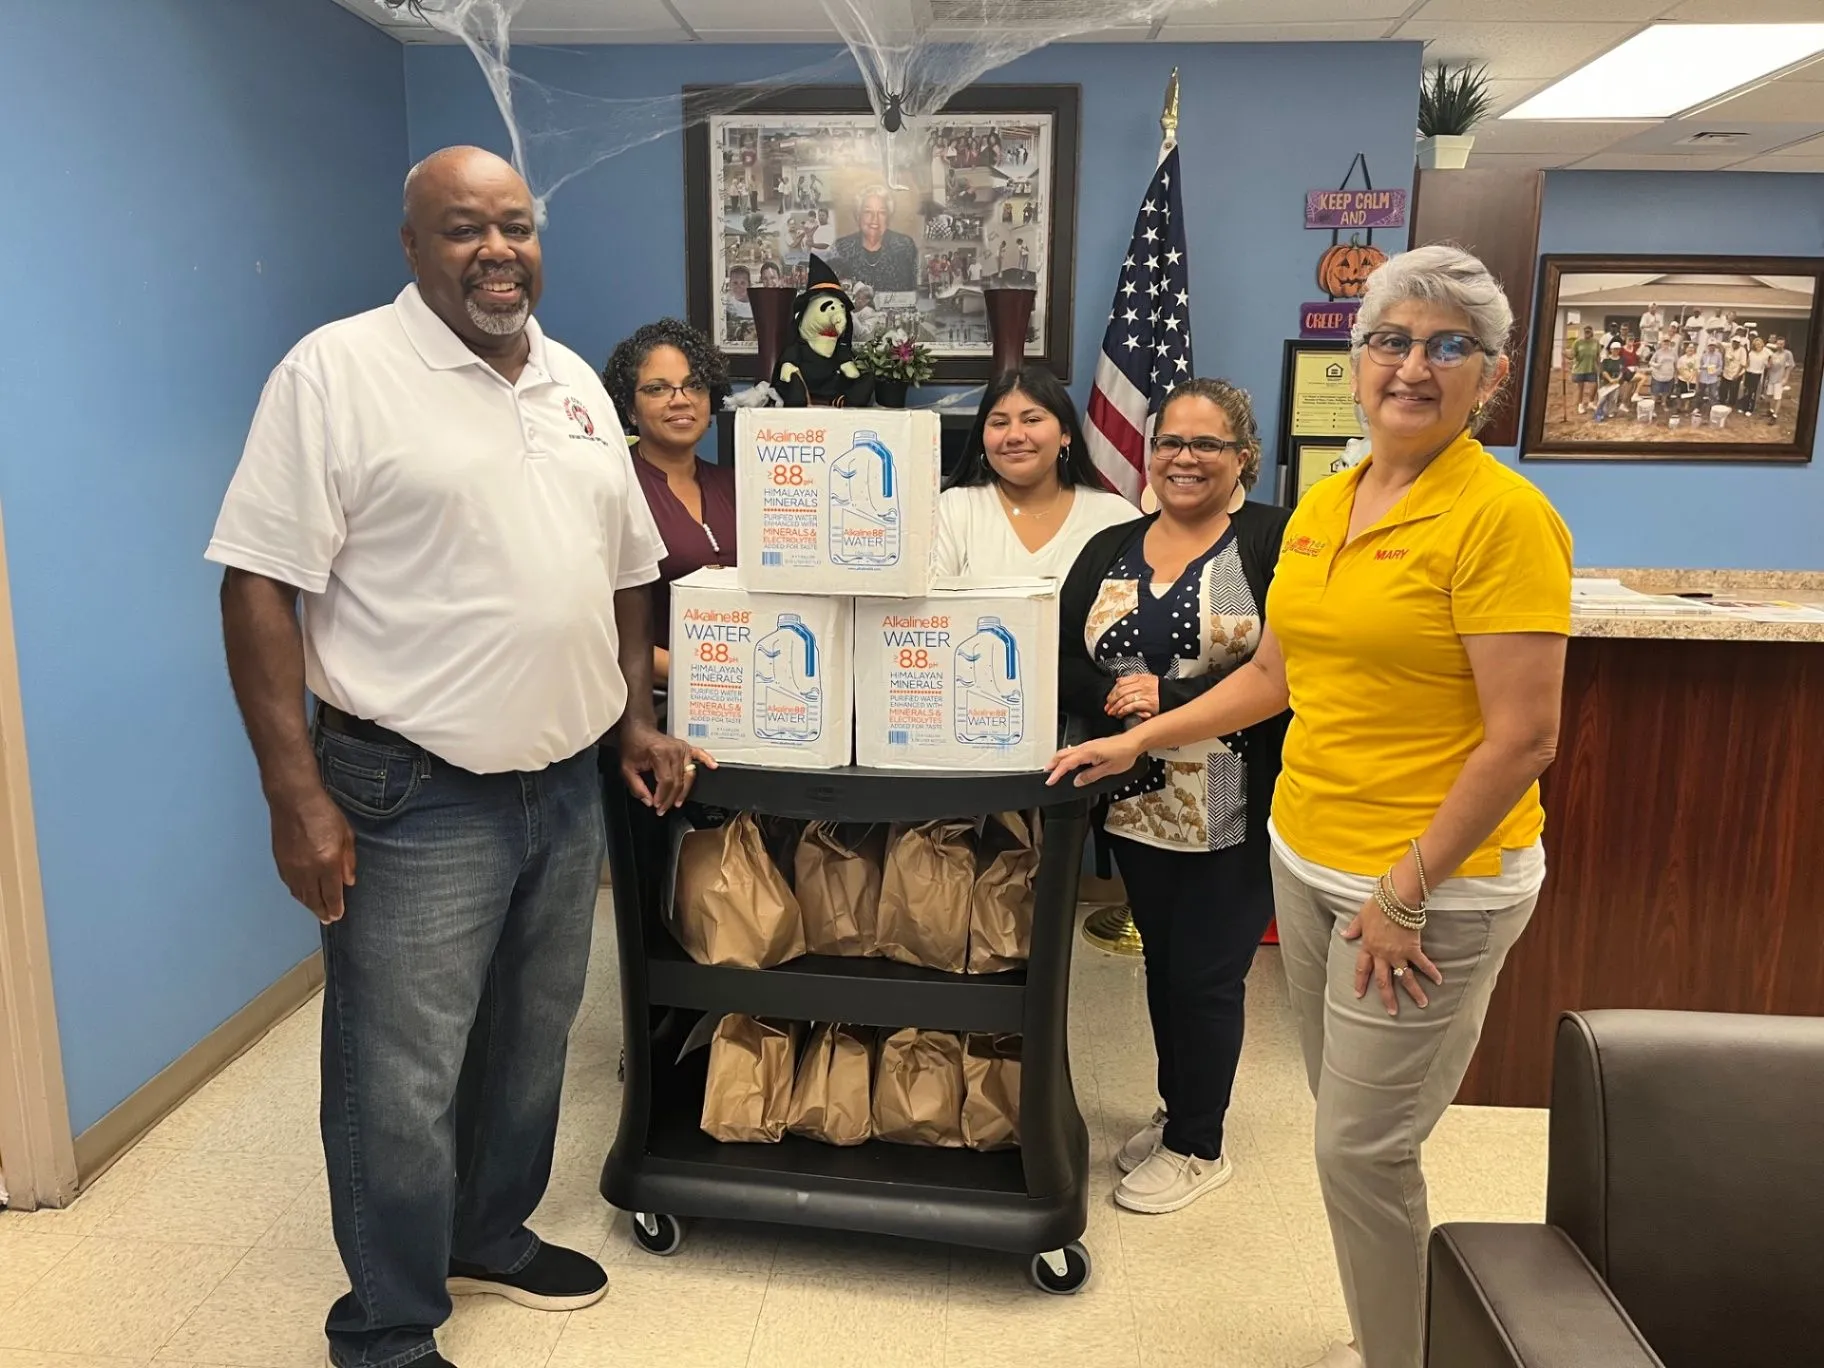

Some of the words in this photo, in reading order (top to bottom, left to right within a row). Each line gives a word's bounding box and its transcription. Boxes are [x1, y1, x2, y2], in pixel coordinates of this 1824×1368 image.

[1320, 193, 1351, 210] KEEP
[1355, 192, 1389, 209] CALM
[1341, 211, 1367, 225] AND
[1305, 312, 1343, 329] CREEP
[757, 445, 826, 463] WATER
[764, 488, 818, 497] HIMALAYAN
[764, 498, 818, 507] MINERALS
[763, 528, 809, 536] MINERALS
[844, 537, 883, 546] WATER
[1373, 549, 1410, 561] MARY
[684, 623, 751, 642] WATER
[883, 631, 951, 647] WATER
[690, 664, 743, 674] HIMALAYAN
[690, 673, 743, 683] MINERALS
[890, 680, 943, 689] MINERALS
[690, 701, 734, 710] MINERALS
[890, 708, 934, 716] MINERALS
[767, 713, 805, 723] WATER
[967, 716, 1007, 727] WATER
